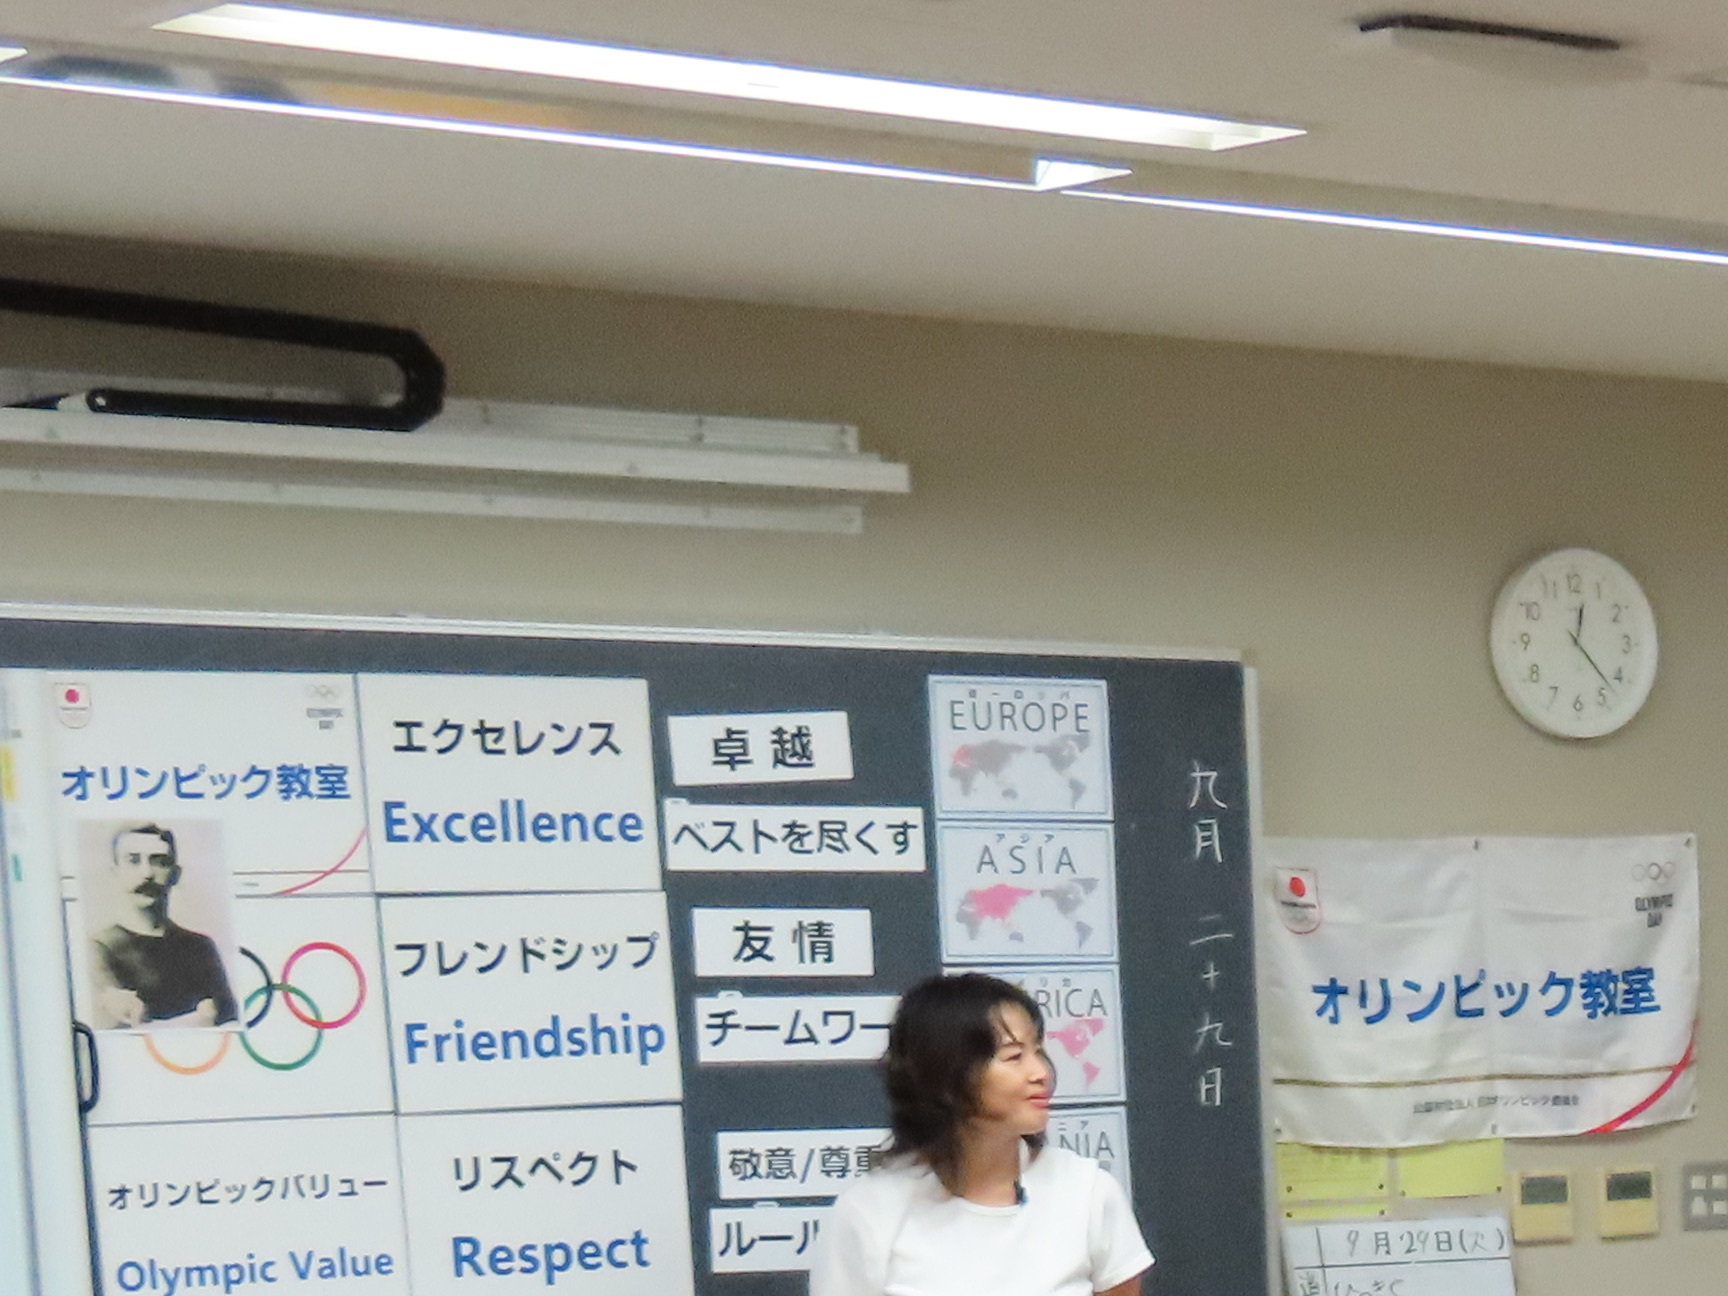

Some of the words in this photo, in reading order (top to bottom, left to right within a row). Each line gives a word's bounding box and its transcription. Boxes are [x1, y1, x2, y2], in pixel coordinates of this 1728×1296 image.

[950, 700, 1091, 732] EUROPE
[393, 719, 622, 757] エクセレンス
[710, 725, 815, 773] 卓越
[61, 765, 352, 801] オリンピック教室
[382, 801, 645, 846] Excellence
[1189, 759, 1229, 864] 九月
[672, 818, 919, 858] ベストを尽くす
[977, 844, 1077, 875] ASIA
[394, 933, 660, 978] フレンドシップ
[731, 919, 836, 965] 友情
[1035, 988, 1108, 1019] RICA
[1311, 965, 1661, 1025] オリンピック教室
[404, 1014, 666, 1067] Friendship
[705, 1009, 892, 1047] チームワー
[451, 1148, 639, 1191] リスペクト
[107, 1173, 389, 1212] オリンピックバリュー
[287, 1249, 395, 1282] Value
[451, 1229, 651, 1285] Respect
